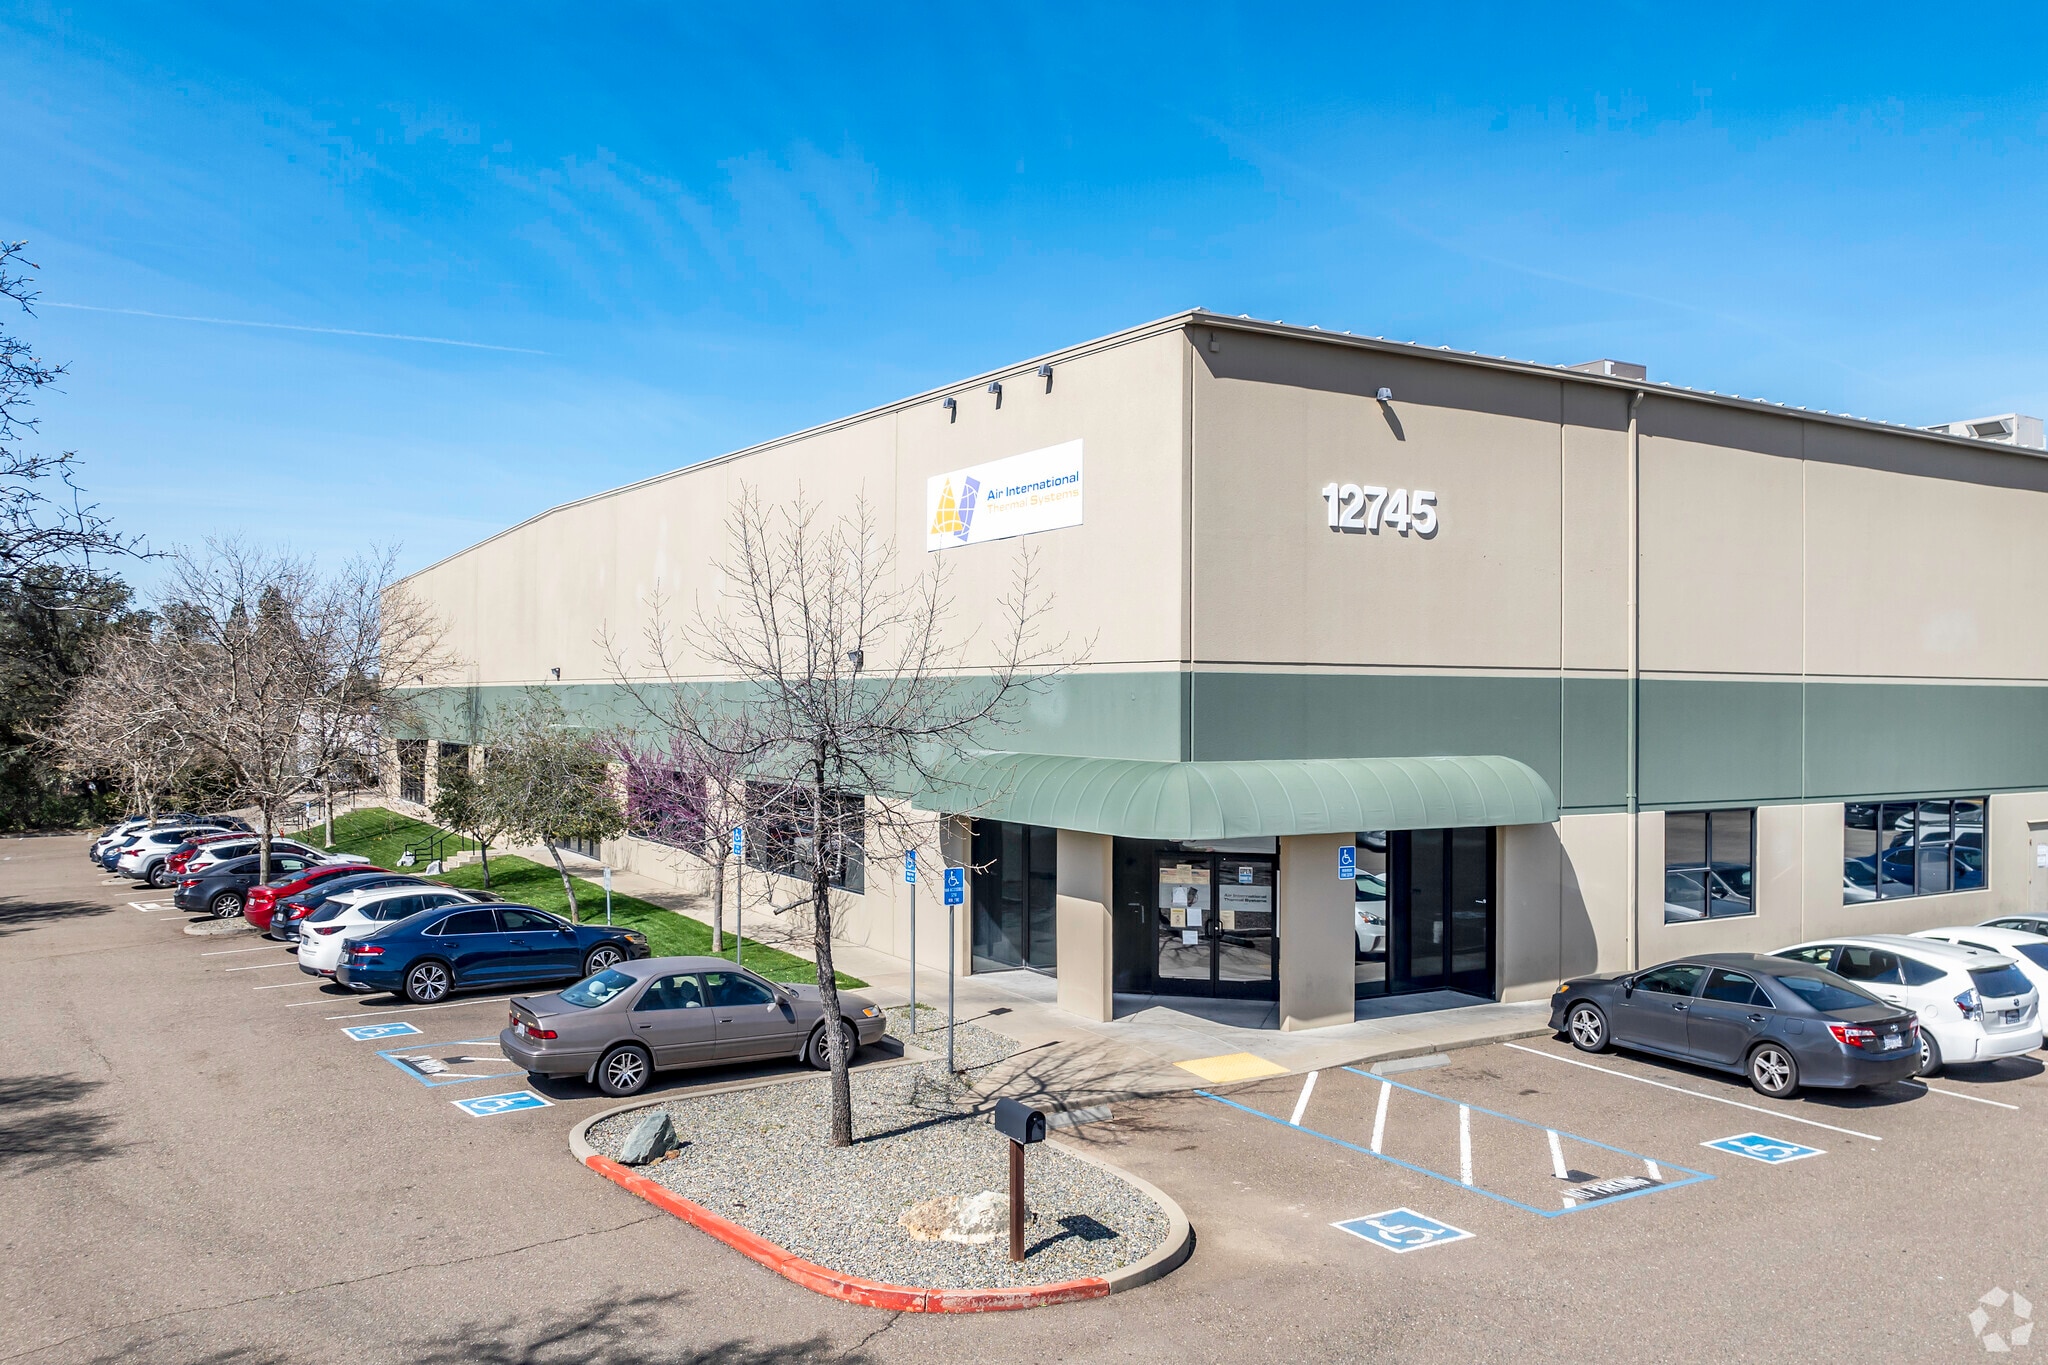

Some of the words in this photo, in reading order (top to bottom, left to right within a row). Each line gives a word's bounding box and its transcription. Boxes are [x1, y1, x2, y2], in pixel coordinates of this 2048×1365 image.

[987, 489, 1004, 501] Air
[1006, 471, 1079, 497] International
[987, 498, 1028, 514] Thermal
[1030, 489, 1080, 506] Systems
[1322, 482, 1438, 535] 12745
